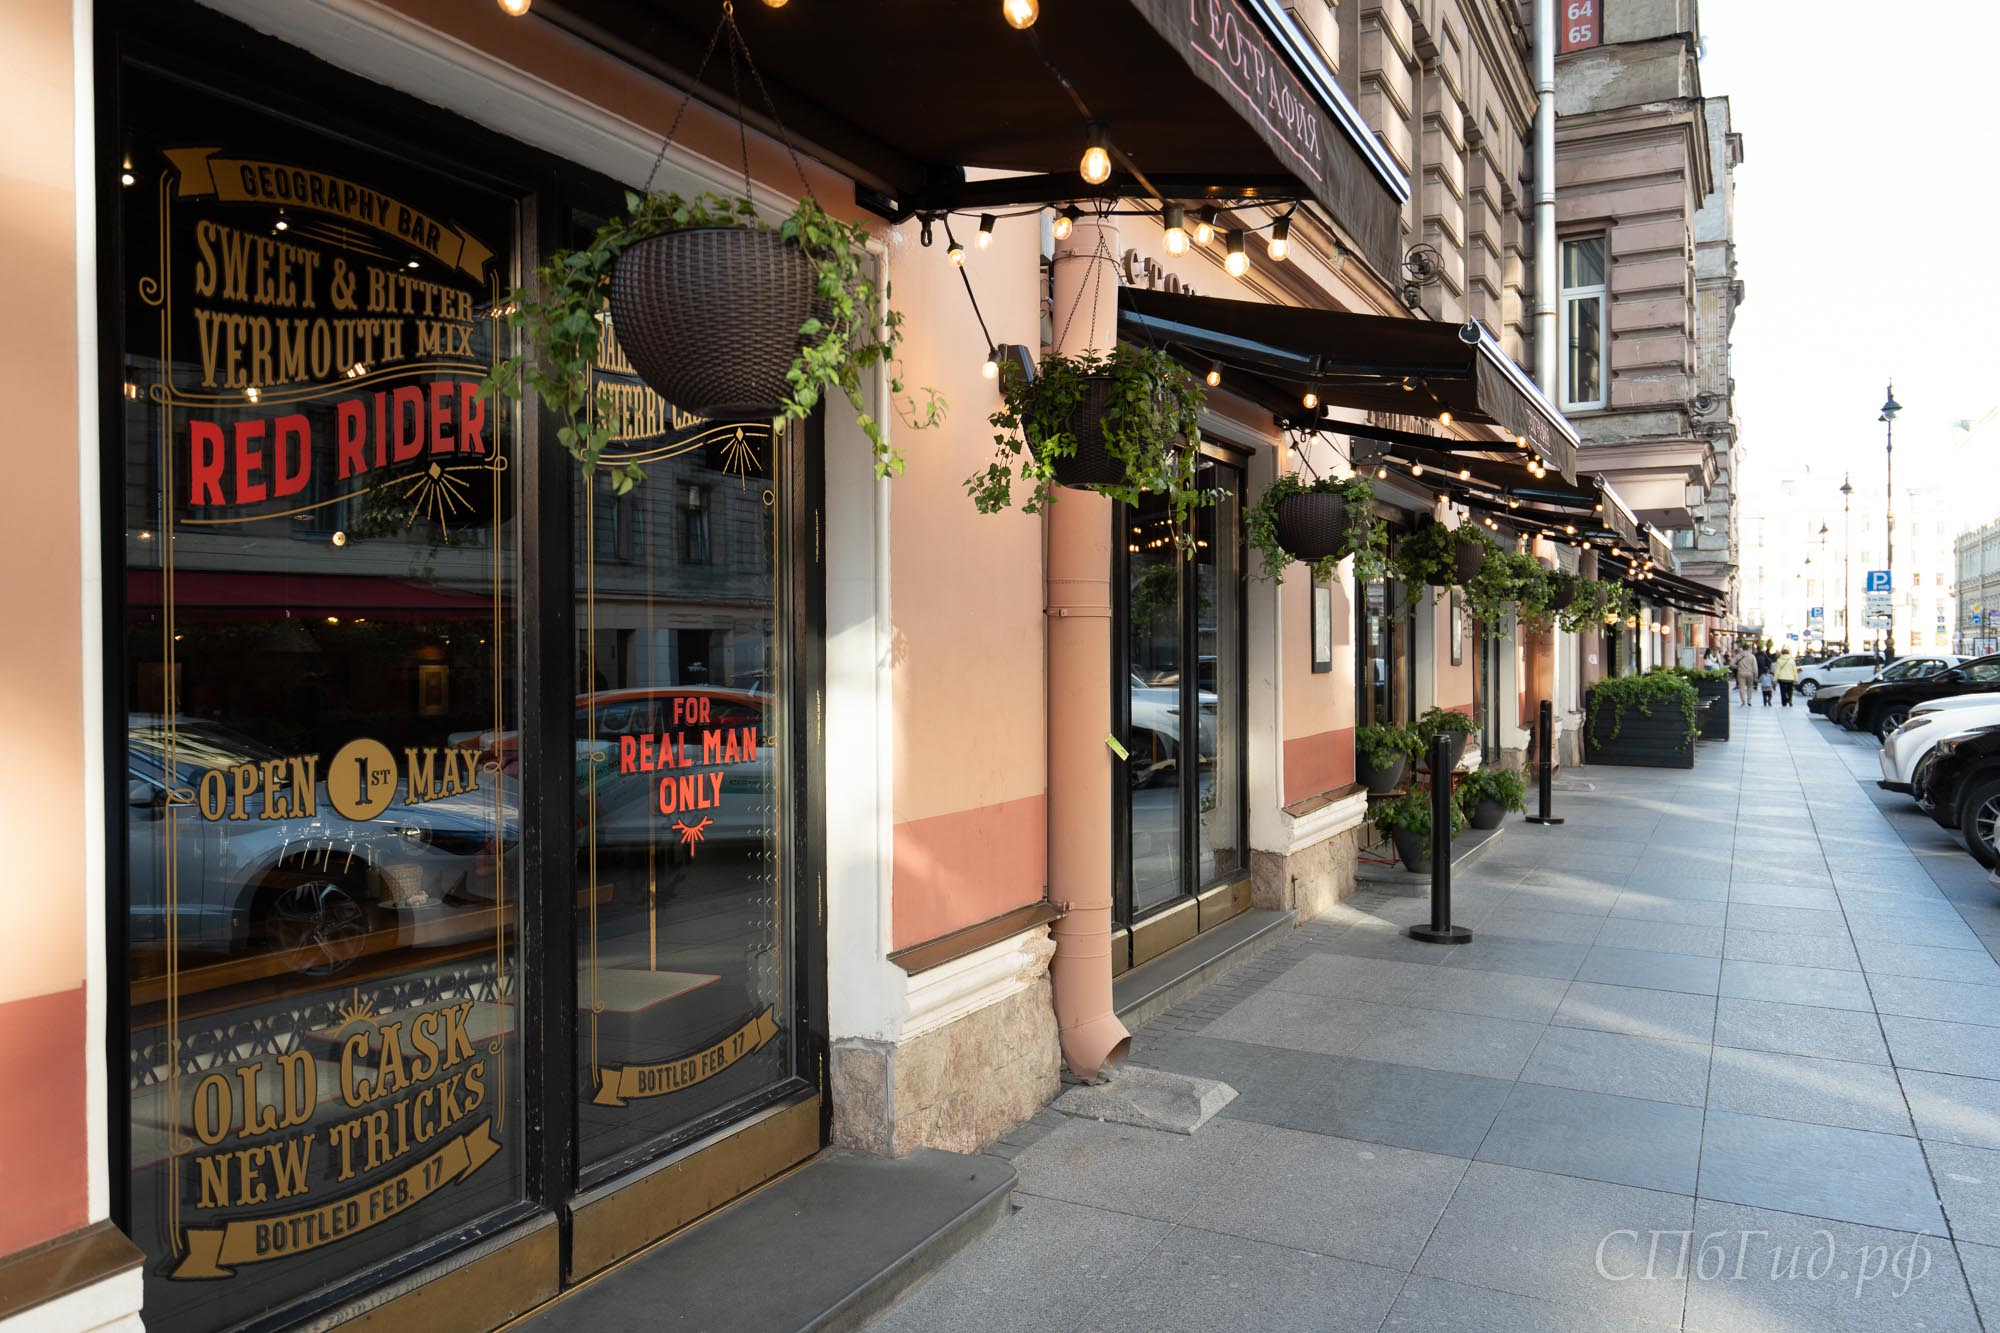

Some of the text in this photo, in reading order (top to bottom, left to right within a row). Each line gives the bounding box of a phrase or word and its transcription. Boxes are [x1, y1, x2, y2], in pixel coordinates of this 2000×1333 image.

[1568, 1, 1592, 20] 64
[1568, 25, 1592, 44] 65
[241, 165, 441, 254] GEOGRAPHY BAR
[196, 219, 474, 322] SWEET & BITTER
[194, 307, 475, 389] VERMOUTH MIX
[189, 381, 486, 506] RED RIDER
[620, 726, 758, 774] REAL MAN
[673, 697, 711, 725] FOR
[200, 754, 319, 822] OPEN
[404, 747, 482, 805] MAY
[659, 771, 724, 815] ONLY
[193, 1000, 476, 1145] OLD CASK
[638, 1031, 745, 1093] BOTTLED FEB. 17
[194, 1060, 485, 1209] NEW TRICKS
[255, 1155, 444, 1256] BOTTLED FEB. 17
